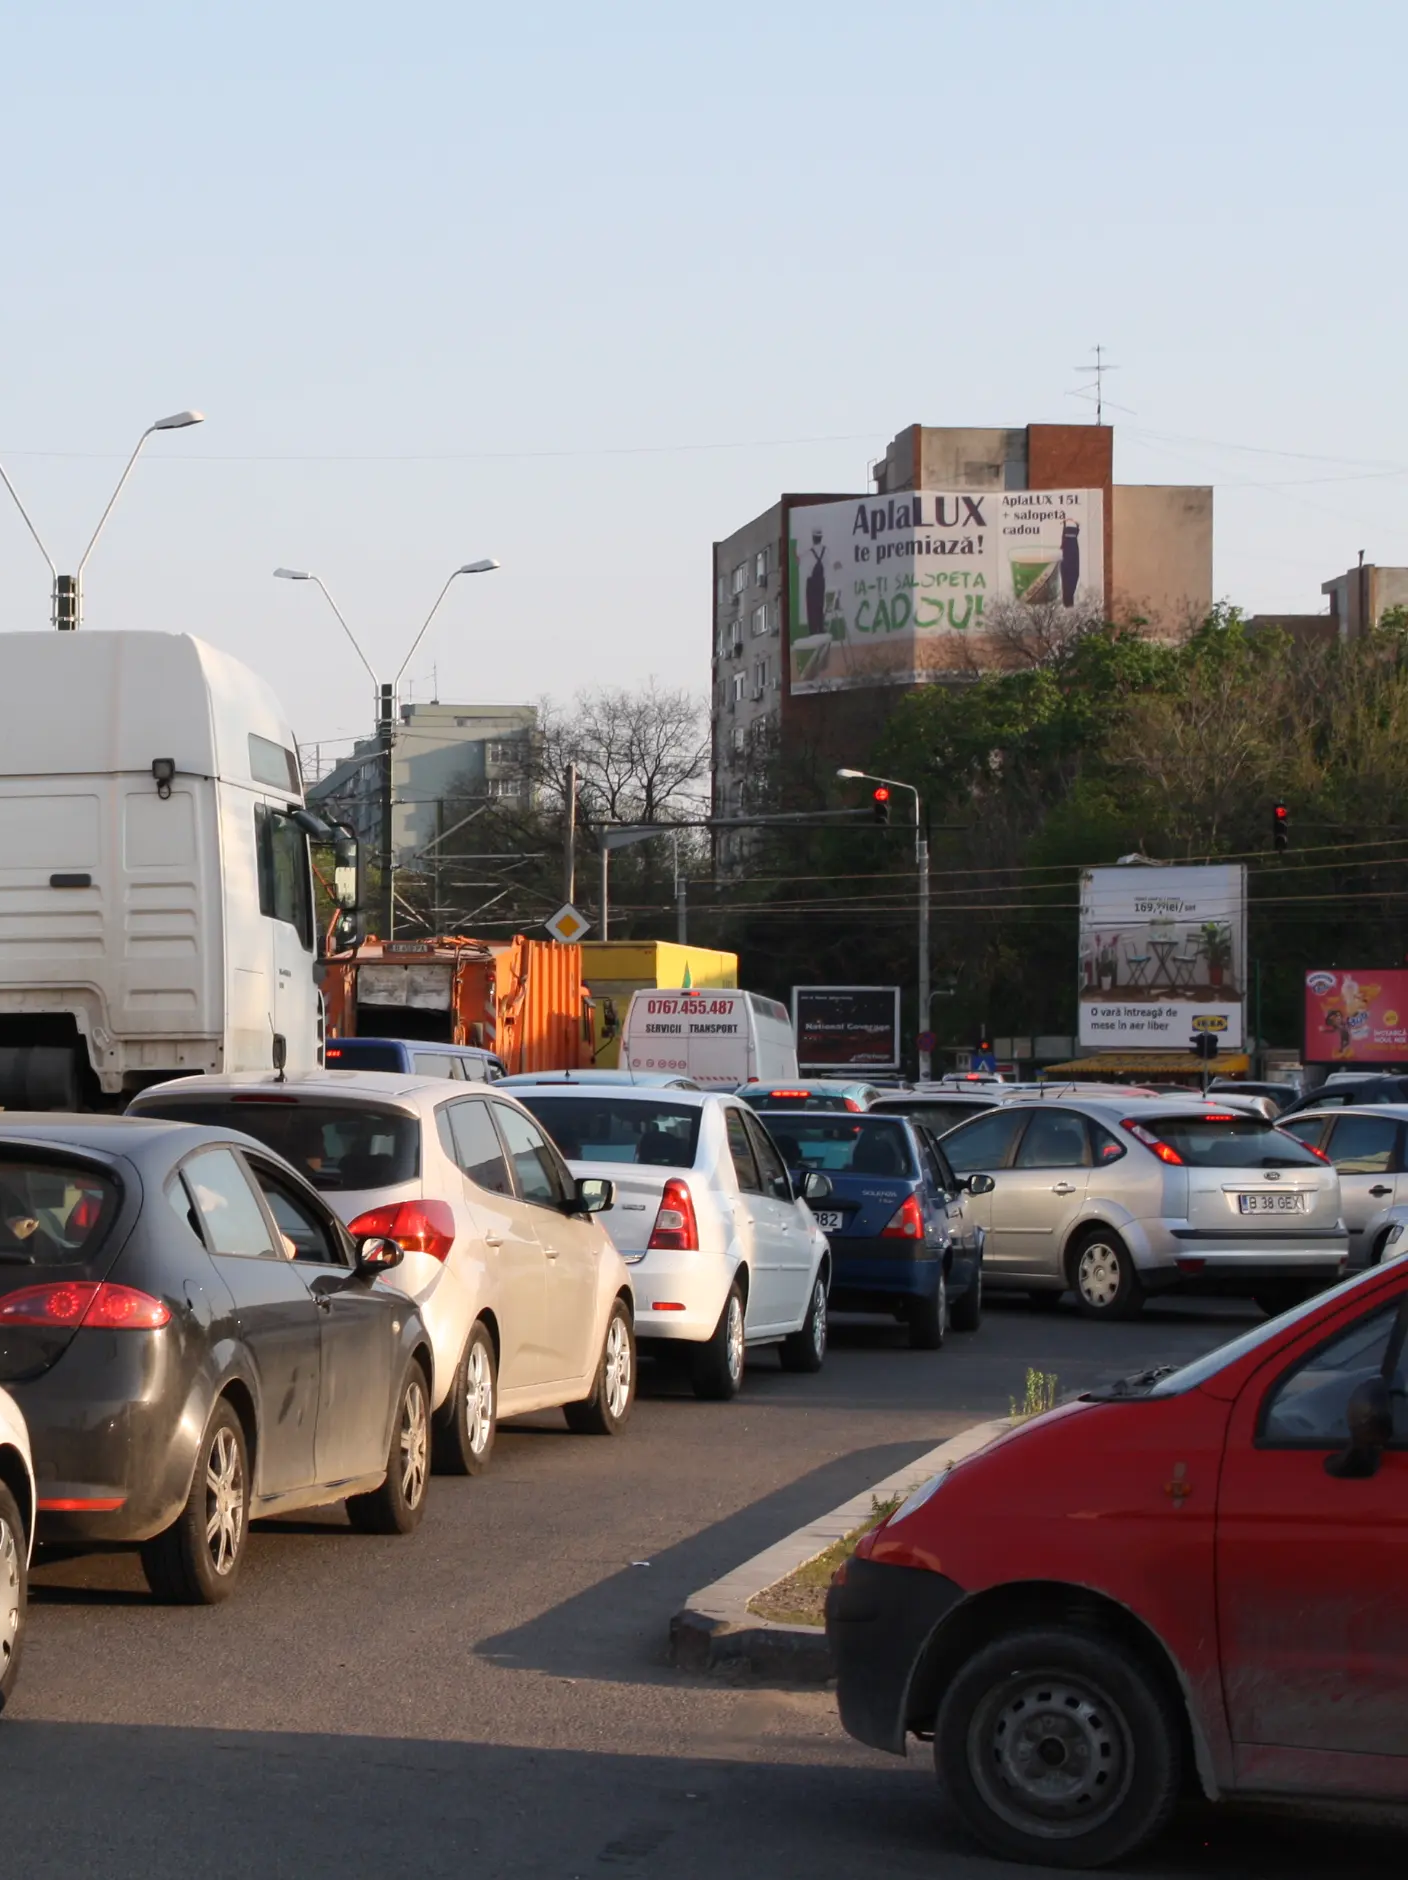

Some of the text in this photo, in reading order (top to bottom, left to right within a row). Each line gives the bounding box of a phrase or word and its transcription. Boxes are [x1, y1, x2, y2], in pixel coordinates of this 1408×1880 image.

[1002, 494, 1053, 507] AplaLUX
[852, 495, 987, 541] AplaLUX
[1002, 524, 1040, 535] cadou
[854, 534, 984, 565] te premiază!
[854, 592, 984, 635] CADOU!
[647, 1000, 734, 1015] 0767.455.487
[1166, 1007, 1178, 1017] de
[645, 1024, 738, 1034] SERVICII TRANSPORT
[805, 1023, 891, 1034] National Coverage
[1091, 1022, 1116, 1031] mese
[1130, 1022, 1144, 1030] aer
[1147, 1020, 1169, 1031] liber
[1249, 1196, 1301, 1210] B 38 GEX
